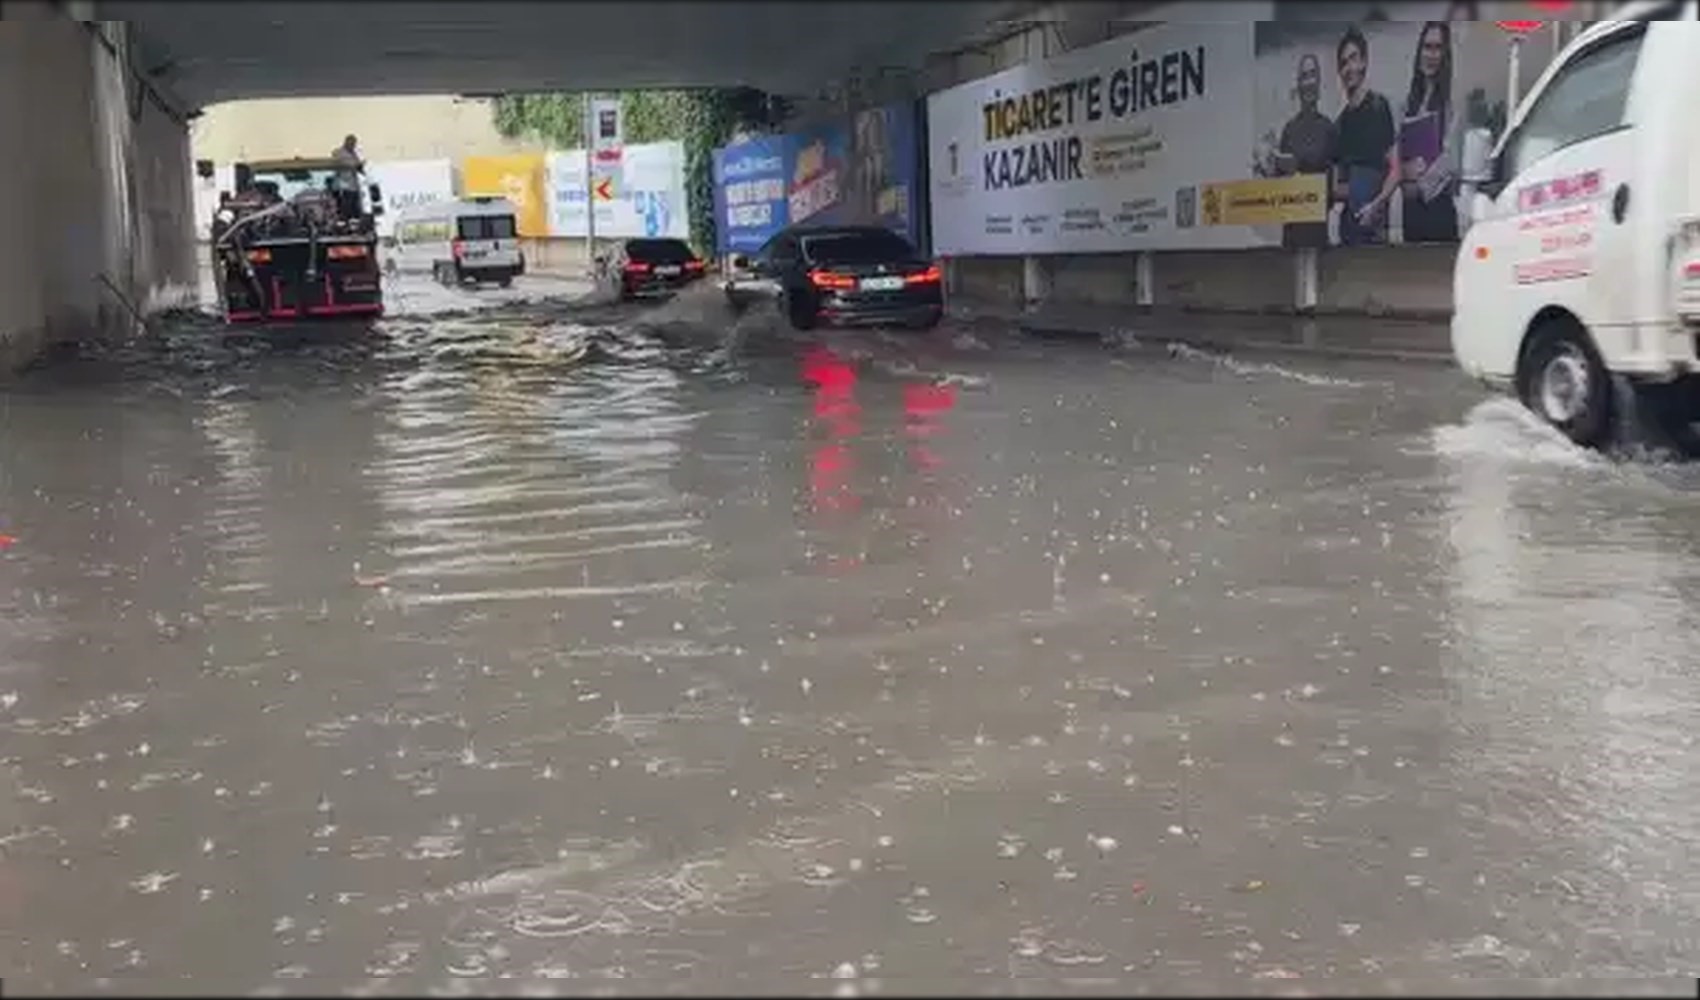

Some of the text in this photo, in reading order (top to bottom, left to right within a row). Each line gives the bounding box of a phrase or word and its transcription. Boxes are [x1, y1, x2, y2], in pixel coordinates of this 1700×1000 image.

[983, 46, 1205, 141] TİCARET'E GİREN
[983, 136, 1083, 190] KAZANIR
